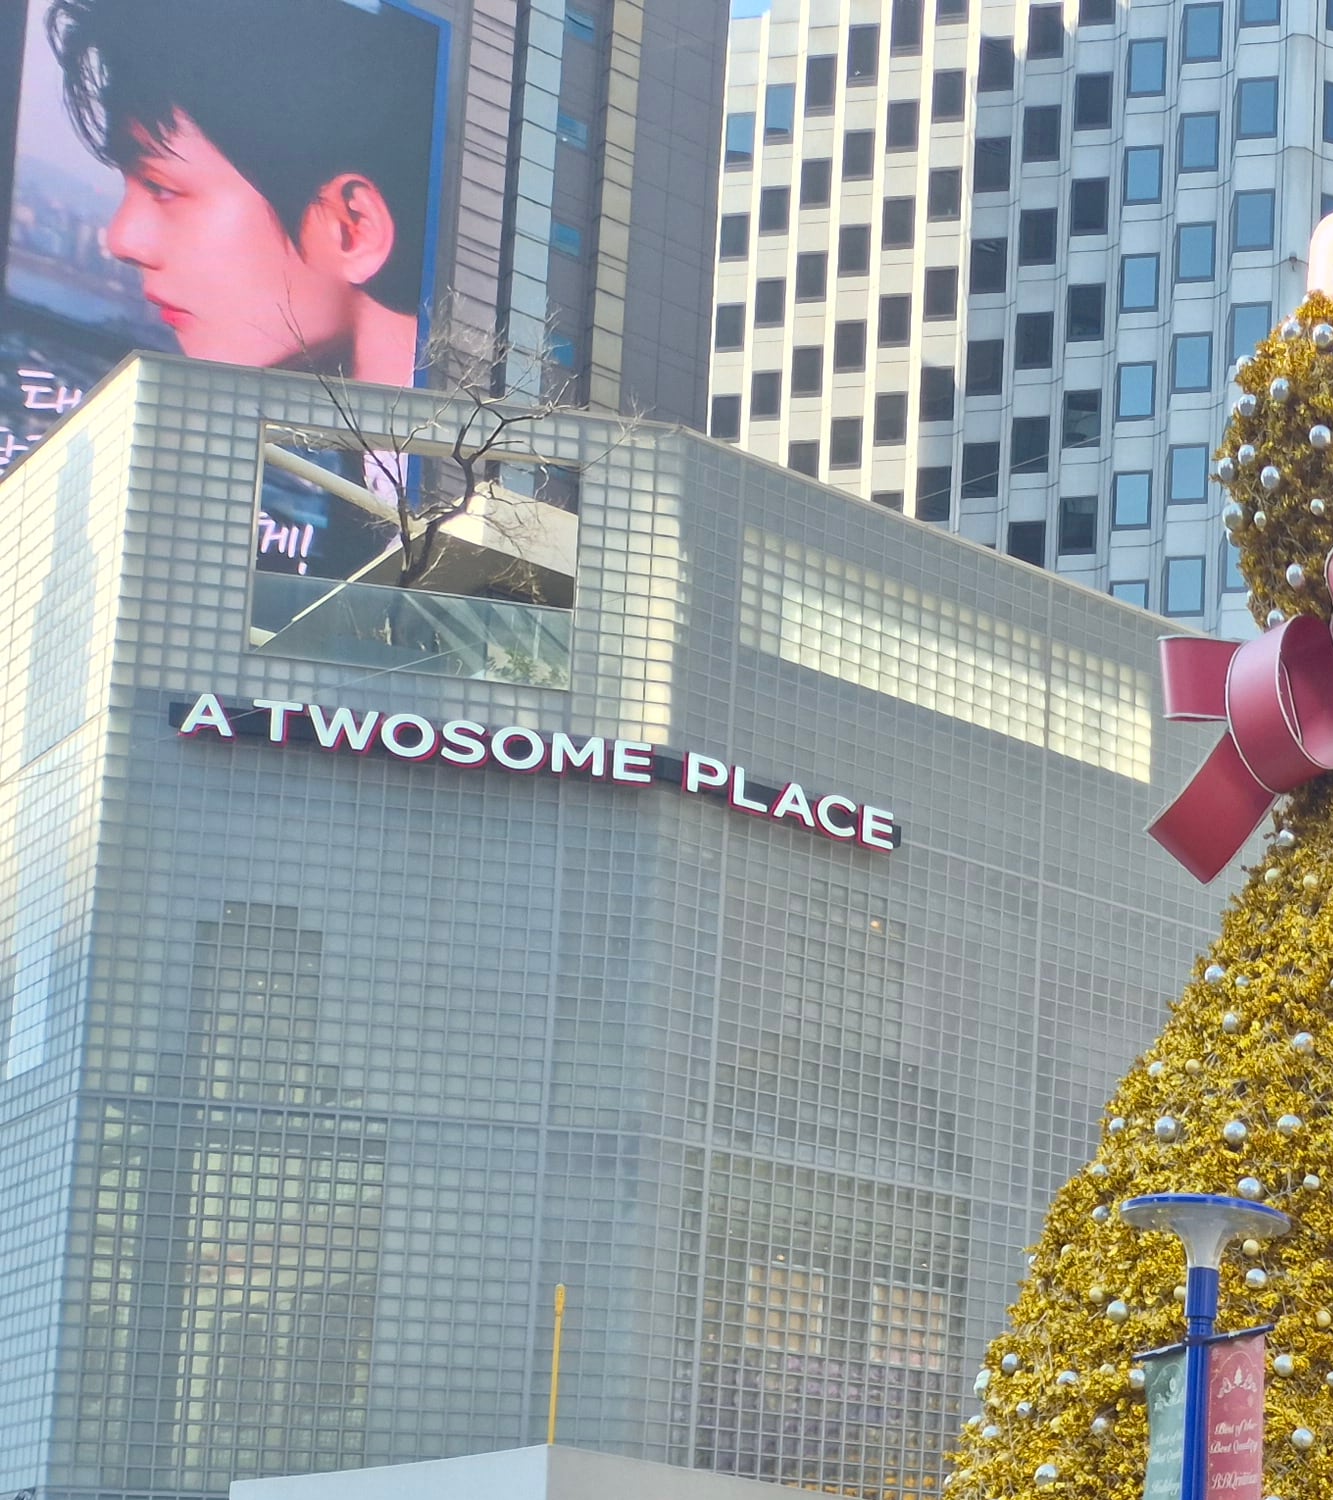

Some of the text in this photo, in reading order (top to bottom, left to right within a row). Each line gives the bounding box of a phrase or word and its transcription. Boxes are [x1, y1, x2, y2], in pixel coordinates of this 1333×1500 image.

[179, 693, 897, 852] A TWOSOME PLACE
